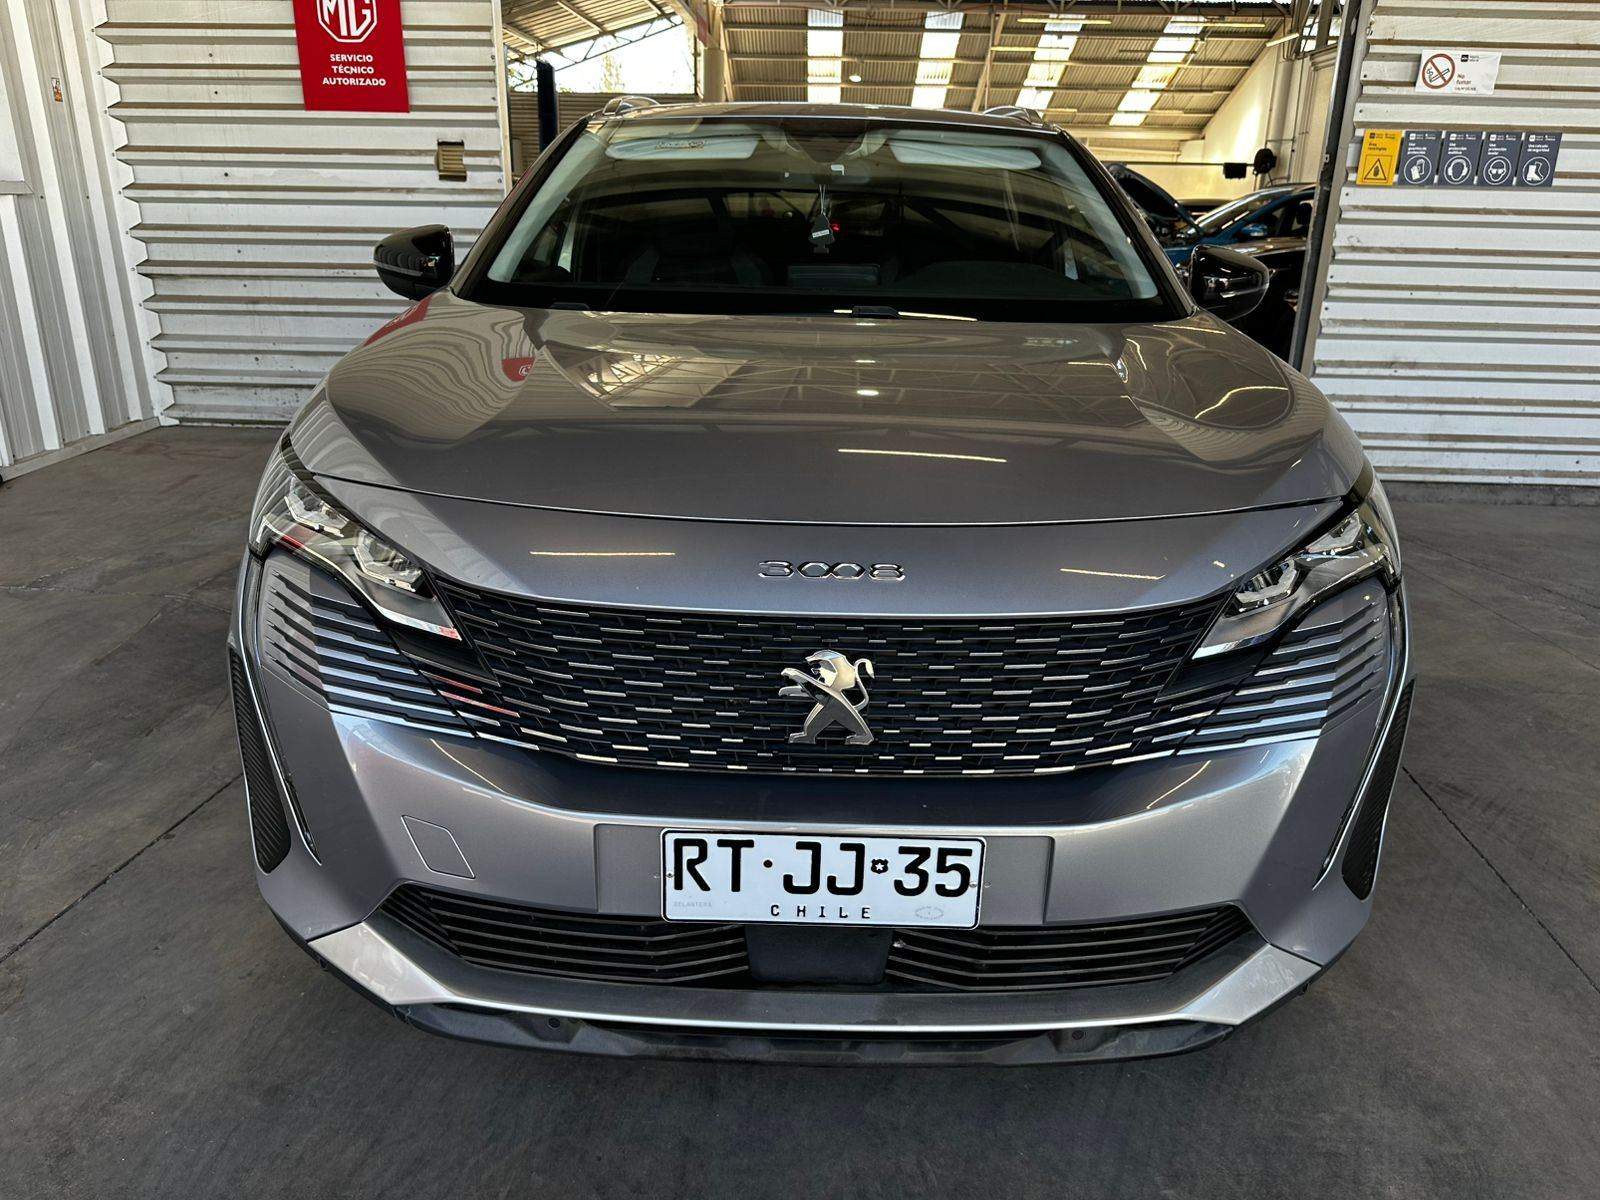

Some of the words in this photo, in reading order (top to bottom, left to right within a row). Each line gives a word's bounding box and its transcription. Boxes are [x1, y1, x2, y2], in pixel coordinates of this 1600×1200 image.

[330, 53, 374, 62] SERVICIO
[331, 64, 374, 74] TÉCNICO
[322, 77, 387, 87] AUTORIZADO
[758, 560, 906, 581] 3008
[770, 904, 871, 919] CHILE
